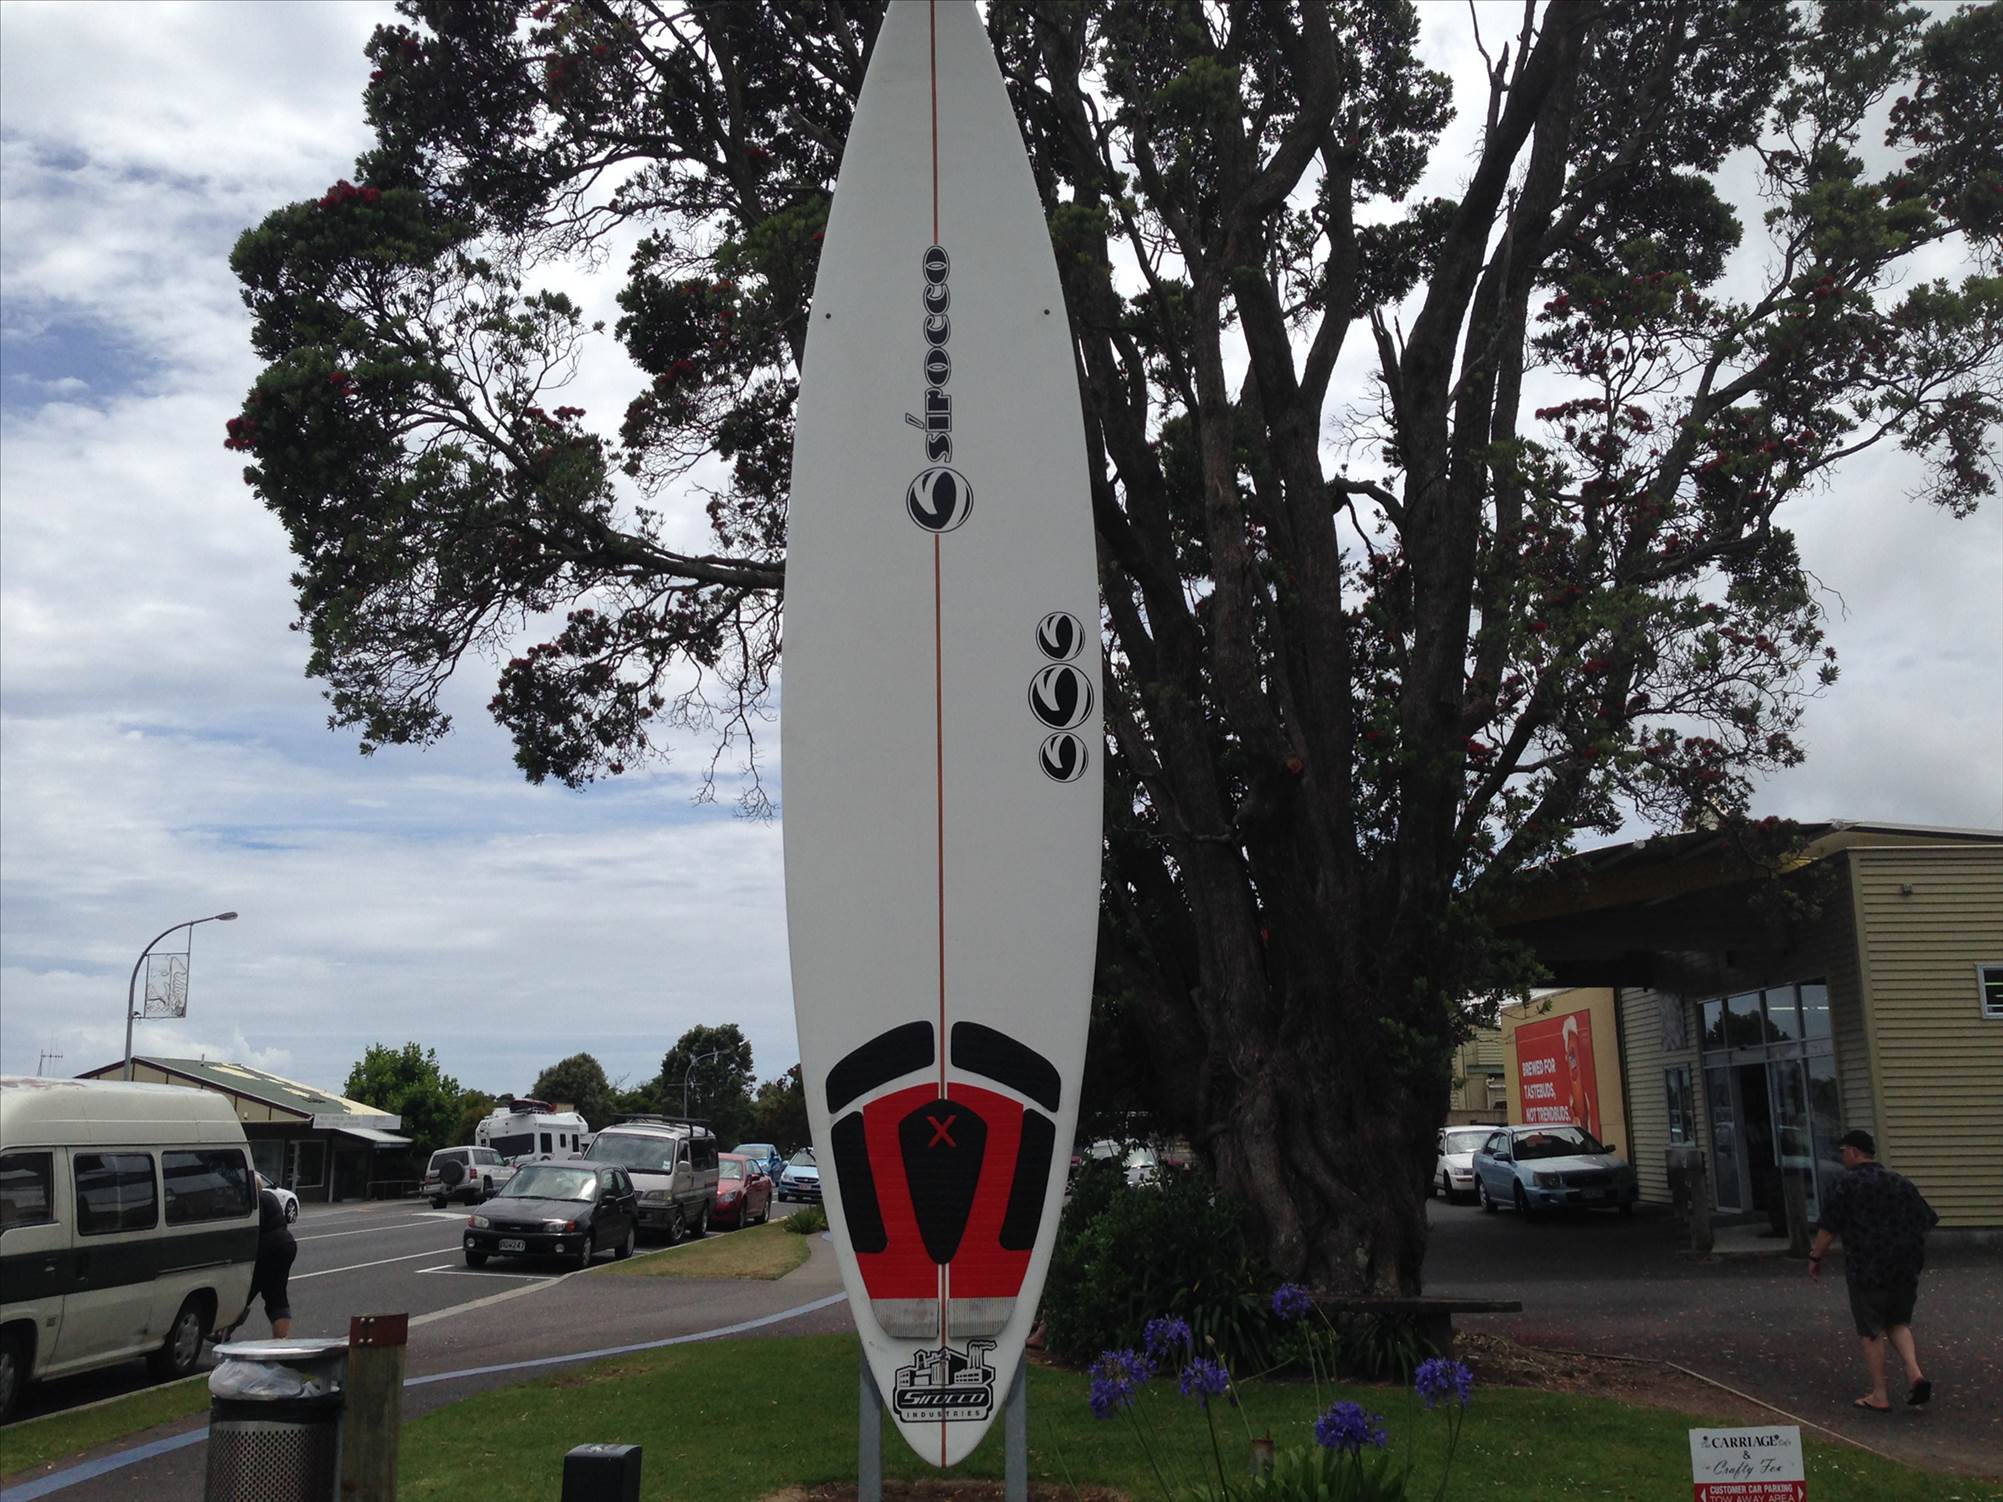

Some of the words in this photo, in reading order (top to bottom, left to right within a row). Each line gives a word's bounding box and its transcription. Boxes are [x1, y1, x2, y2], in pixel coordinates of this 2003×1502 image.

[1522, 1060, 1543, 1077] BREWED
[1544, 1057, 1556, 1074] FOR
[1526, 1107, 1537, 1122] NOT
[906, 1410, 980, 1418] INDUSTRIES
[1711, 1435, 1777, 1448] CARRIAGE
[1743, 1450, 1751, 1460] &
[1713, 1459, 1754, 1479] Crafty
[1709, 1485, 1747, 1495] CUSTOMER
[1748, 1484, 1763, 1494] CAR
[1764, 1483, 1793, 1493] PARKING
